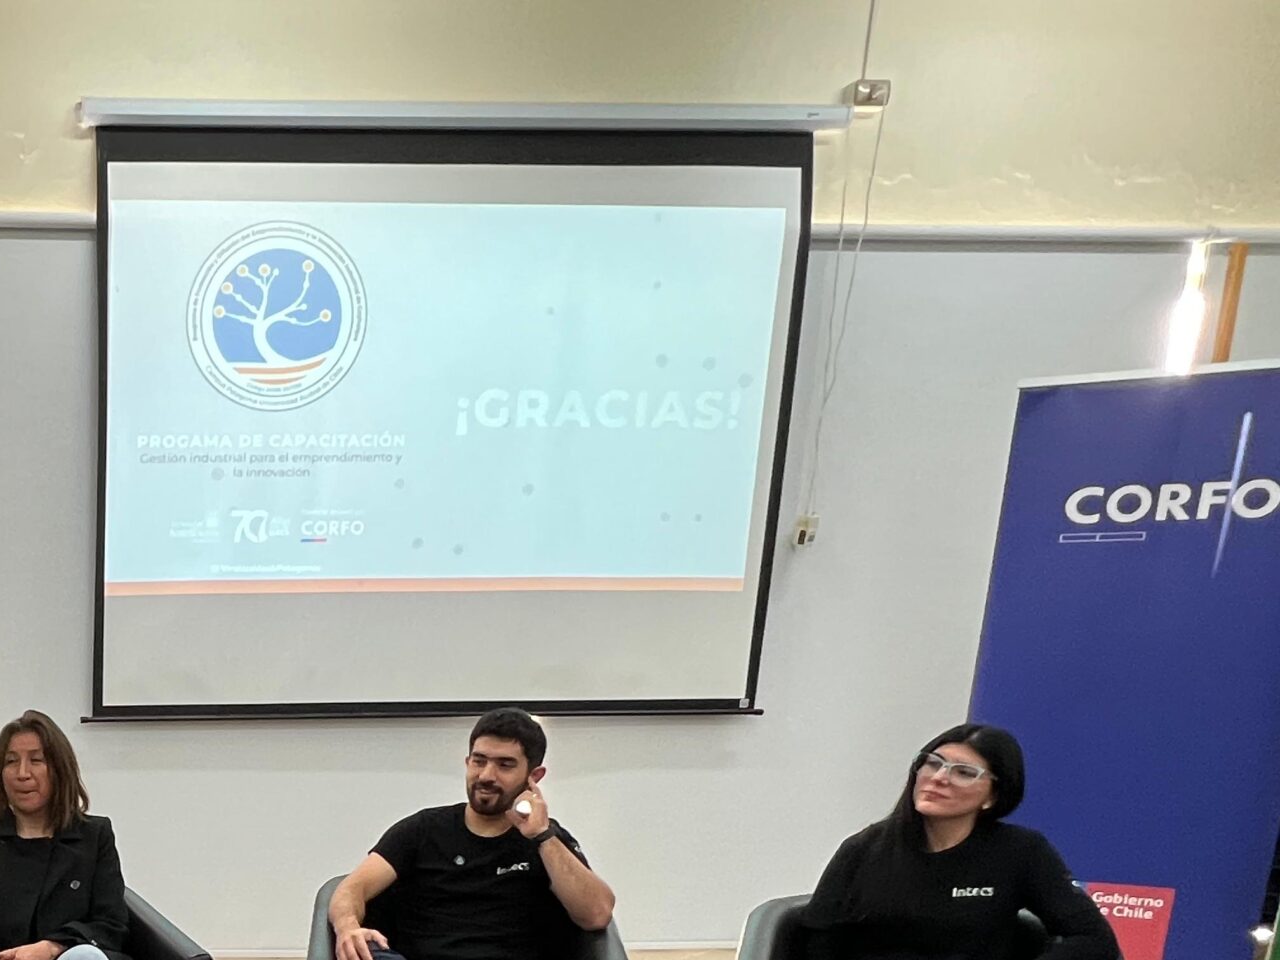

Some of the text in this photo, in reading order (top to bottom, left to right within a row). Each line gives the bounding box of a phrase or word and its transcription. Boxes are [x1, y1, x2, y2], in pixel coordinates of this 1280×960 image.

[455, 387, 741, 436] ¡GRACIAS!
[137, 430, 406, 449] PROGAMA DE CAPACITACIÓN
[139, 452, 403, 466] Gestión industrial para el emprendimiento y
[233, 466, 310, 478] la innovación
[1064, 478, 1280, 525] CORFO
[301, 520, 364, 536] CORFO
[1091, 891, 1164, 908] Gobierno
[1113, 906, 1153, 920] Chile
